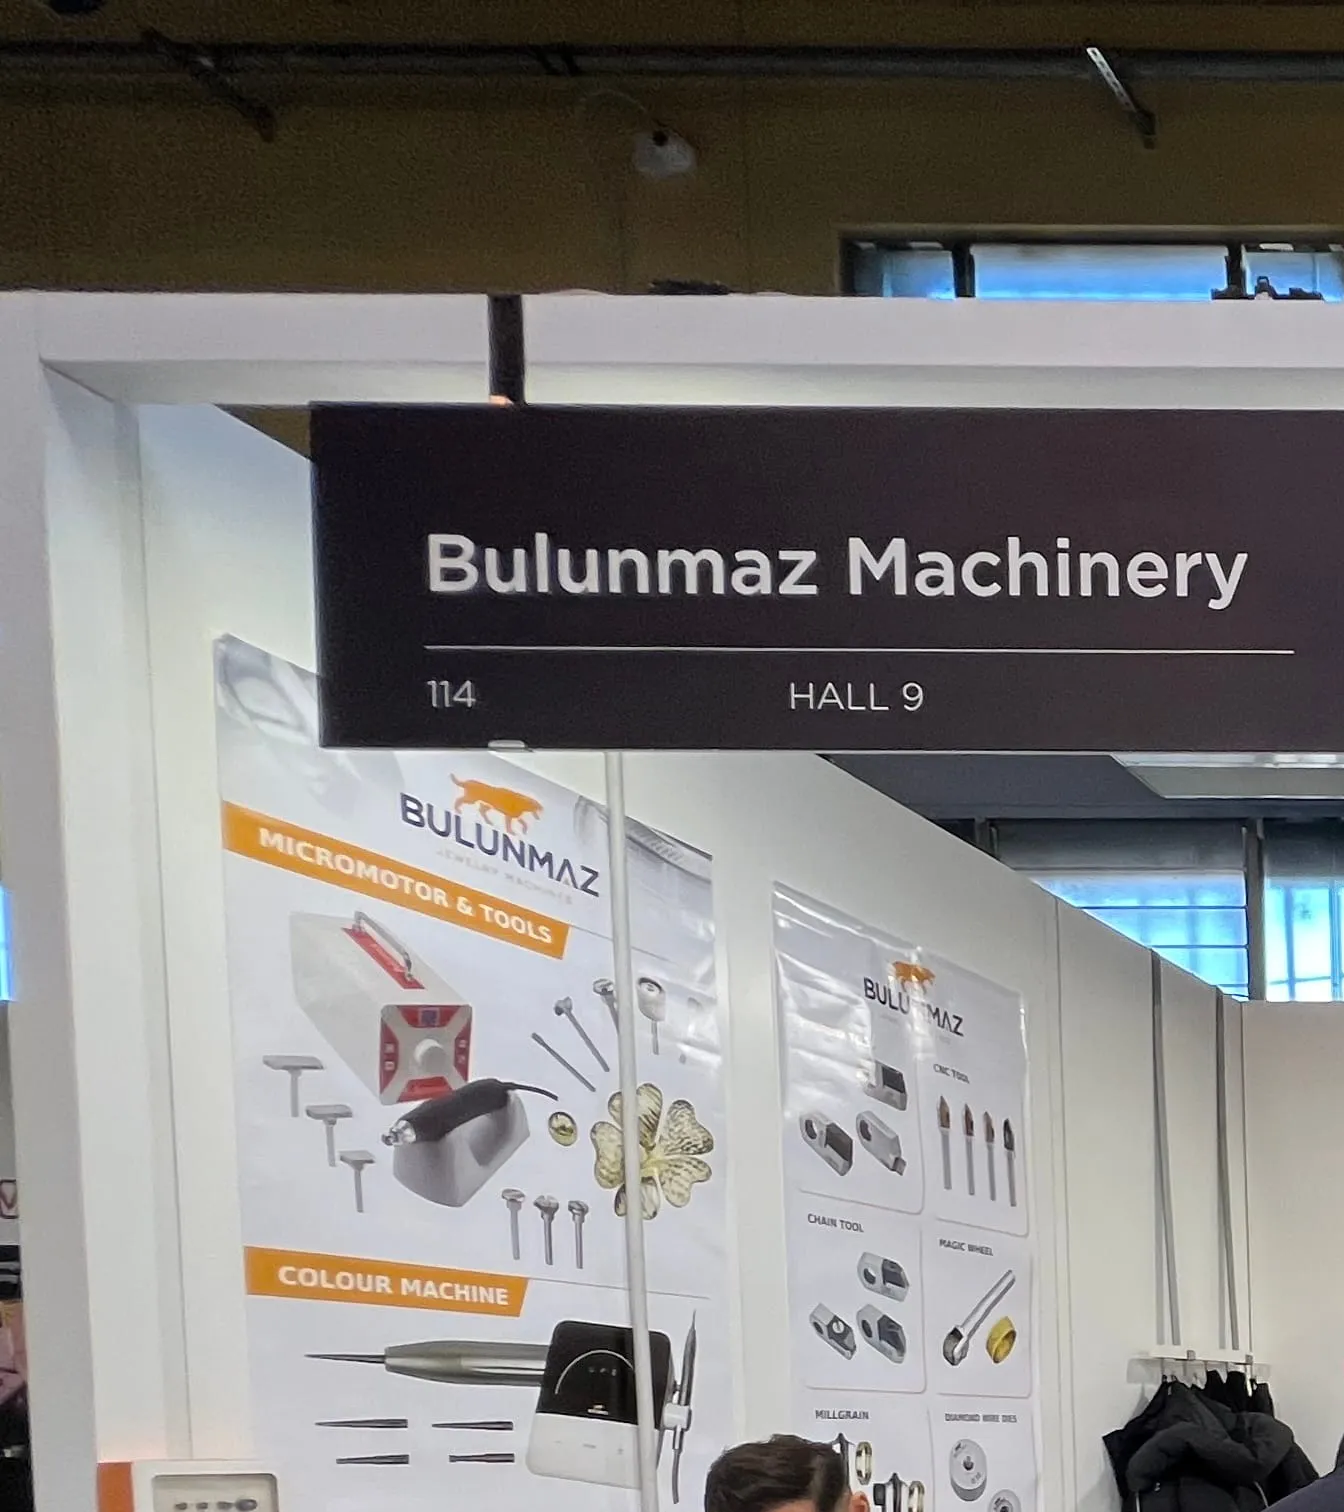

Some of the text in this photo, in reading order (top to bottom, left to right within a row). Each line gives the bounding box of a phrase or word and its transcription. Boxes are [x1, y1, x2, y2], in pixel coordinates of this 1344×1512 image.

[427, 532, 1248, 610] Bulunmaz Machinery
[427, 680, 476, 709] 114
[789, 682, 924, 711] HALL 9
[400, 792, 600, 897] BULUNMAZ
[259, 827, 553, 944] MICROMOTOR & TOOLS
[864, 977, 964, 1037] BULUMAZ
[807, 1212, 865, 1233] CHAIN TOOL
[278, 1266, 509, 1306] COLOUR MACHINE
[815, 1409, 870, 1420] MILLGRAIN
